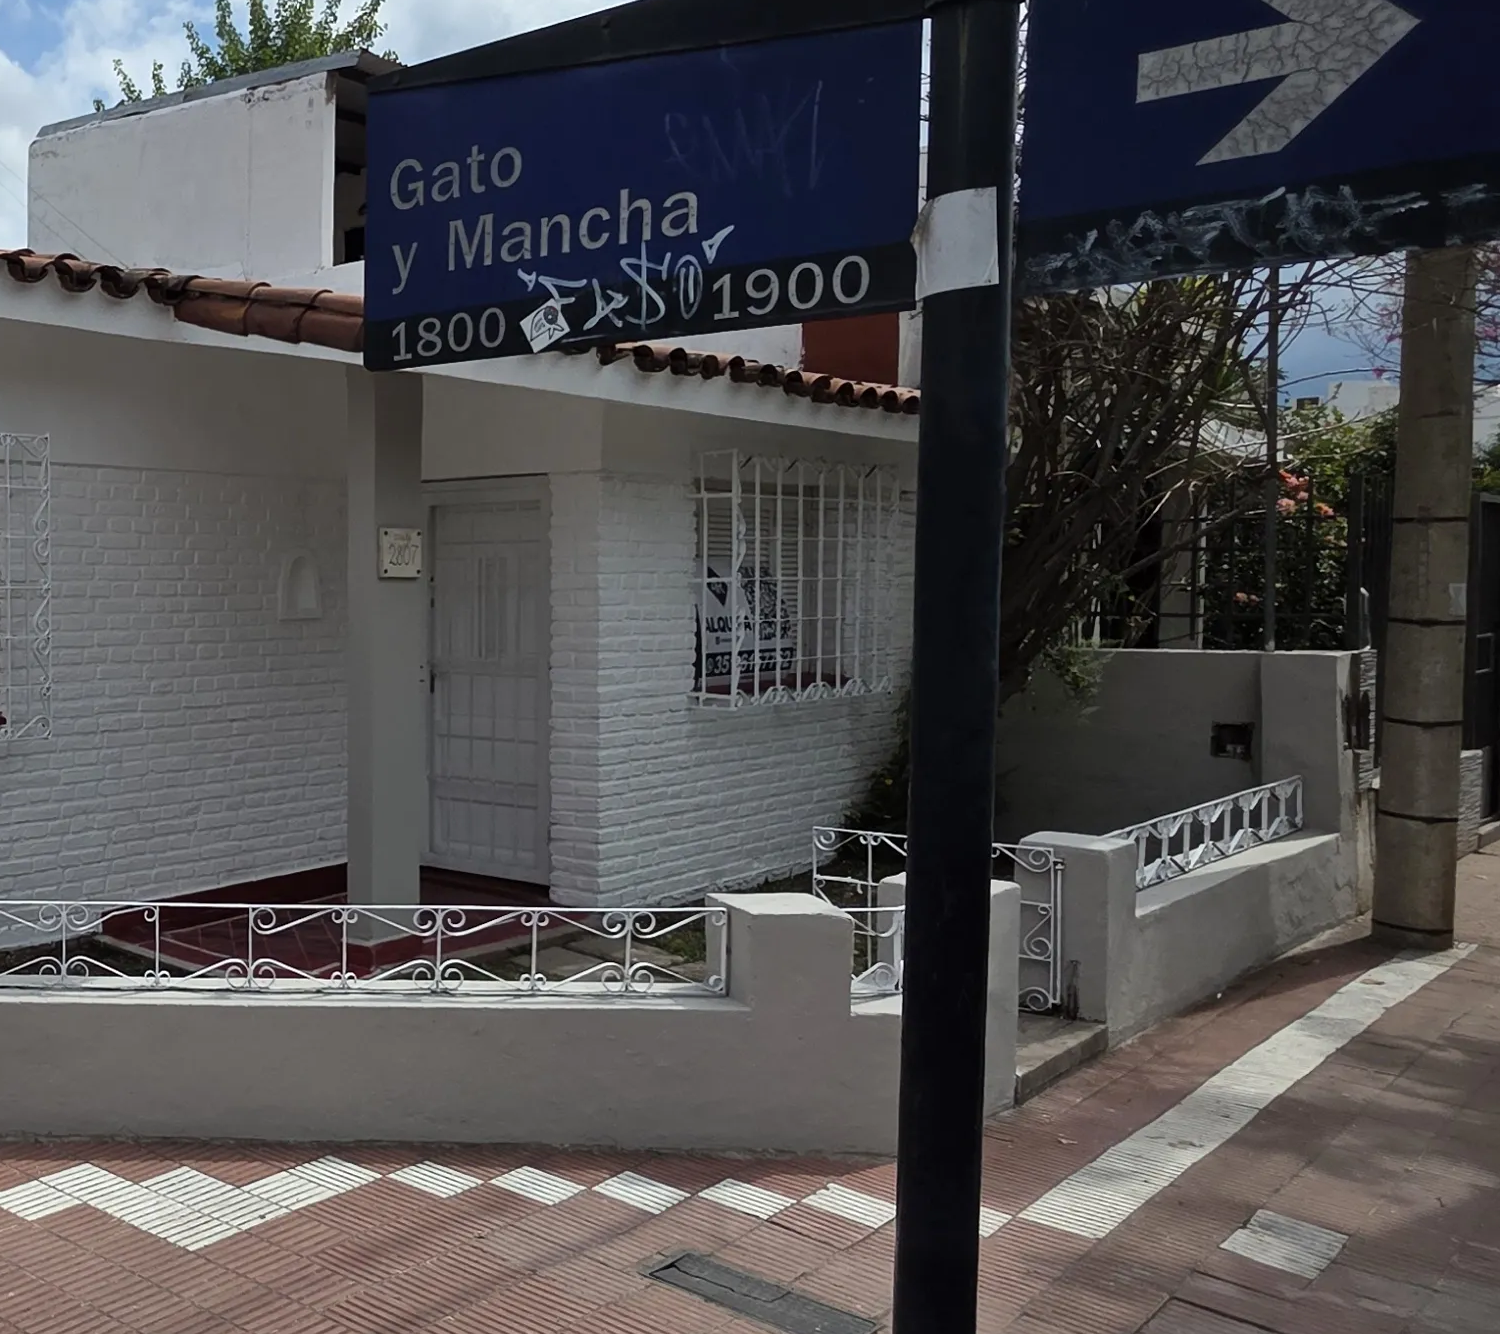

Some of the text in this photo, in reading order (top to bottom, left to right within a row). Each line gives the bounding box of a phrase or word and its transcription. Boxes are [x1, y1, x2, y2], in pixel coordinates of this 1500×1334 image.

[390, 144, 523, 211] Gato
[391, 188, 700, 295] y Mancha
[712, 255, 870, 321] 1900
[391, 307, 507, 362] 1800
[388, 543, 419, 566] 2807
